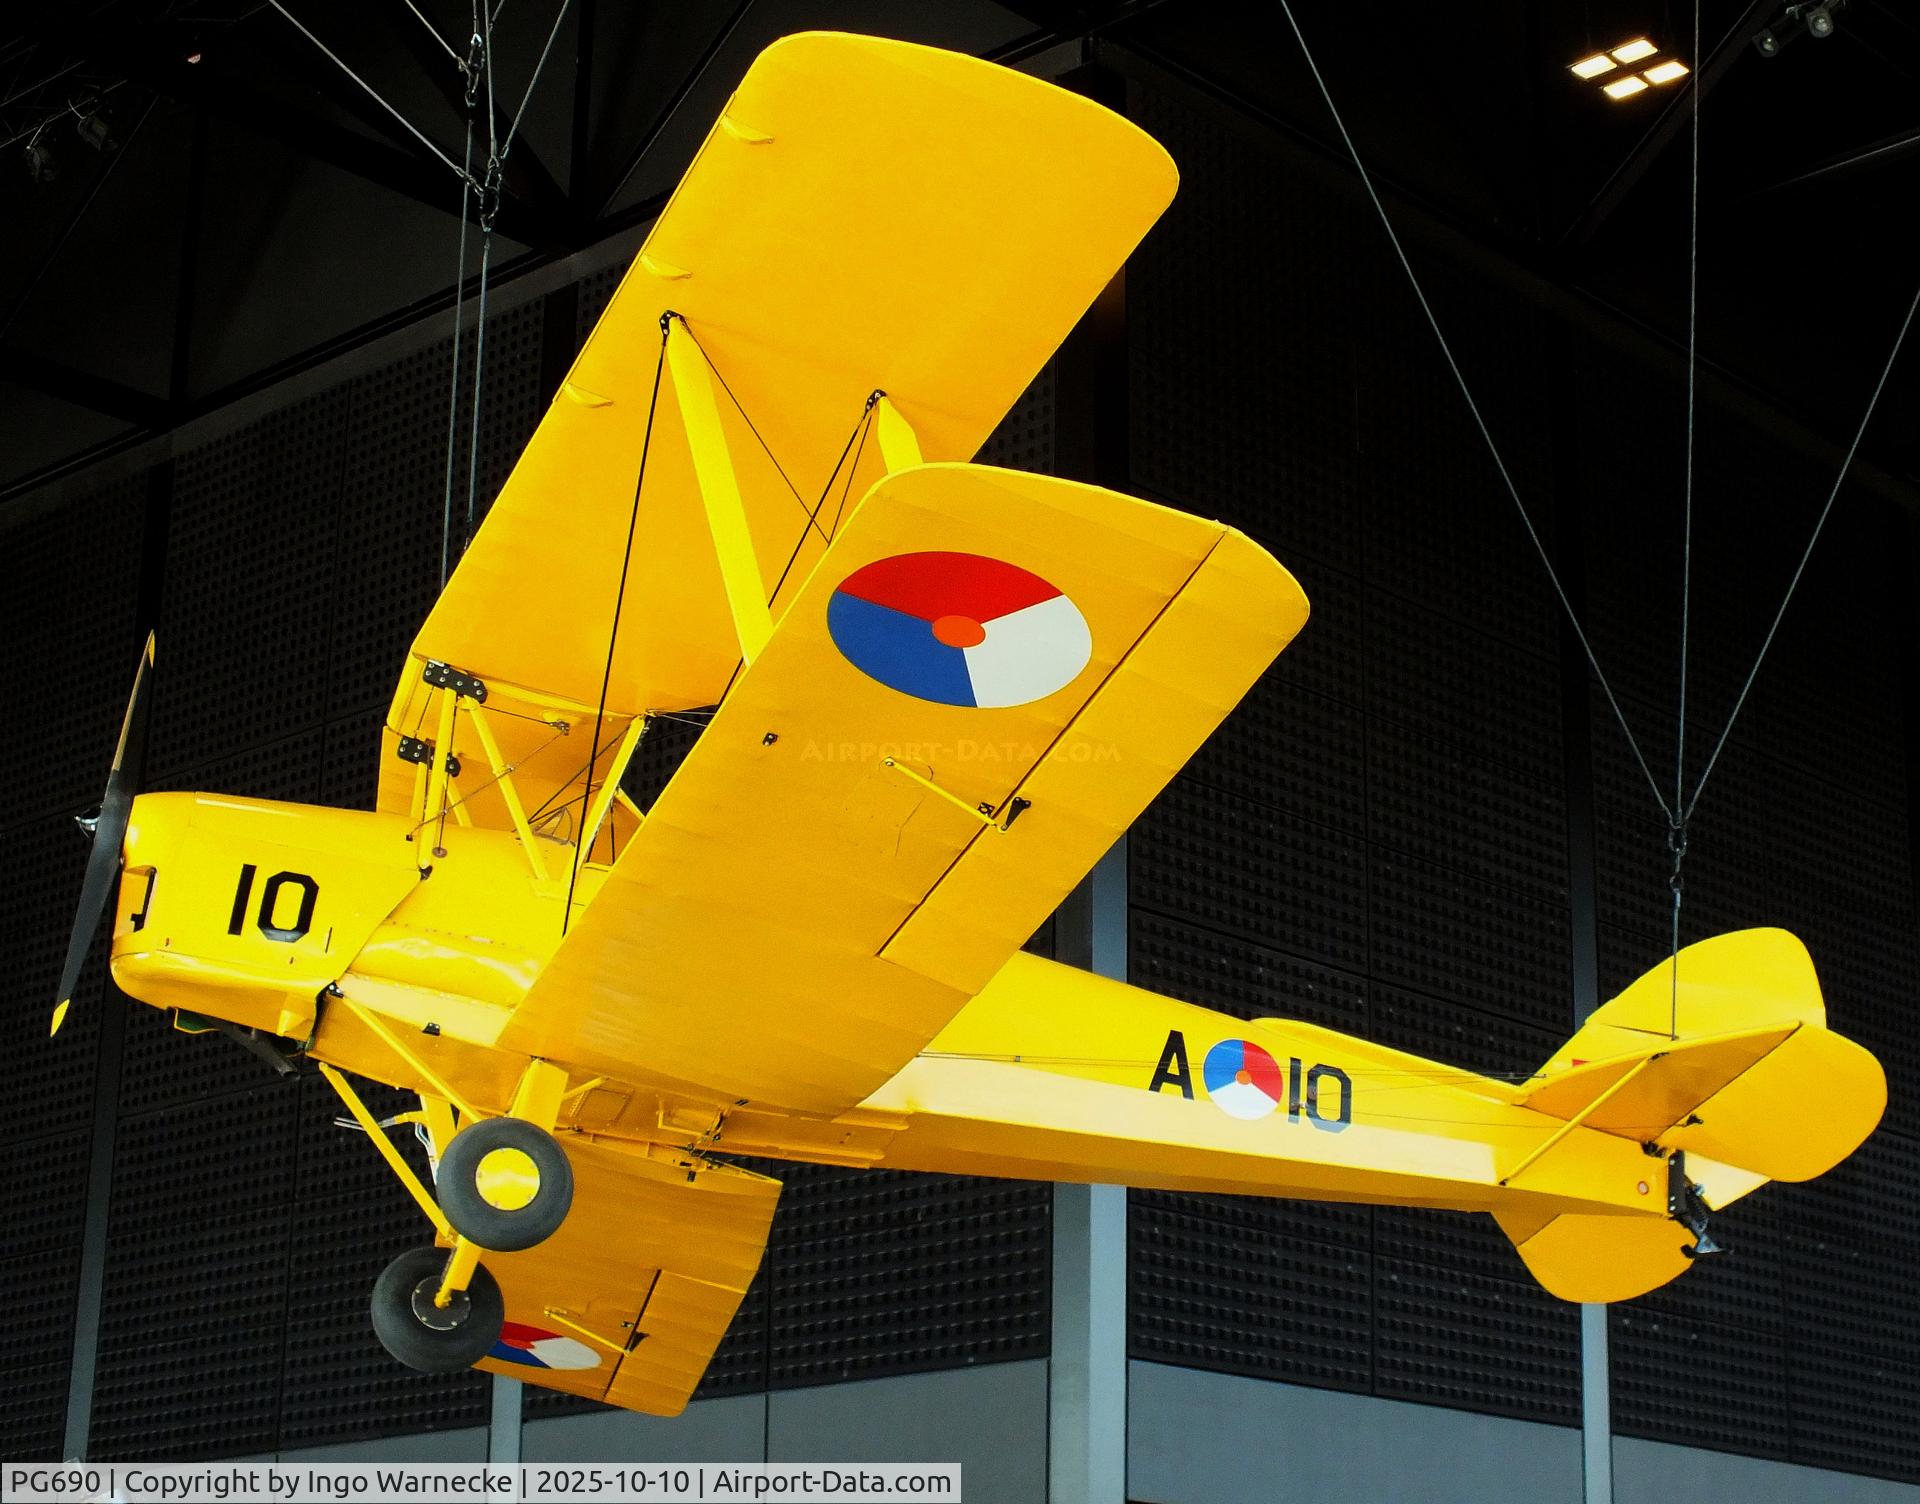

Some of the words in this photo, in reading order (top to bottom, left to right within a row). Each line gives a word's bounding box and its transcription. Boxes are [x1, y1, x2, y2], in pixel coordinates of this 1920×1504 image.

[227, 863, 320, 943] 10
[1148, 1029, 1195, 1101] A
[1287, 1056, 1353, 1134] 10
